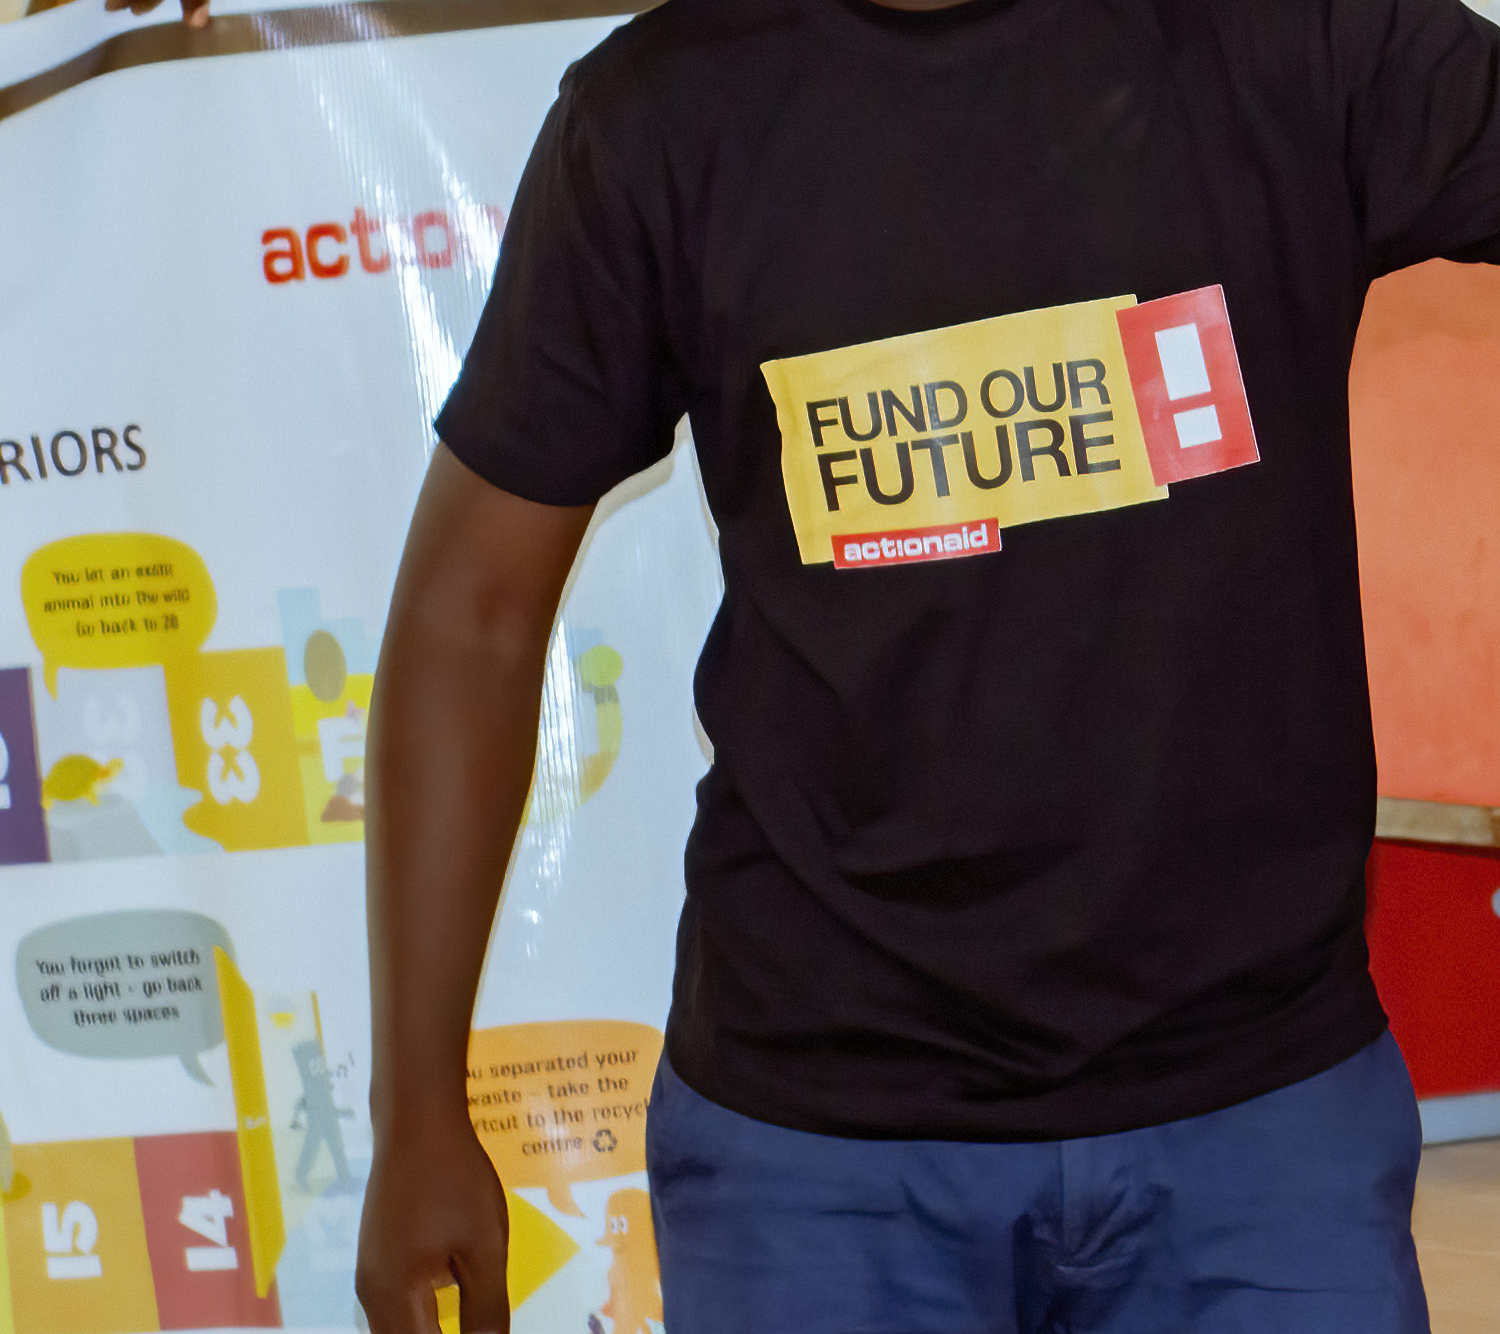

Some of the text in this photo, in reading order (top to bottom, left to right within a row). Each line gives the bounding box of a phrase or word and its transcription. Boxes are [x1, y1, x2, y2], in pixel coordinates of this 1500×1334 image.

[805, 358, 1112, 447] FUND OUR
[817, 410, 1122, 513] FUTURE
[44, 594, 95, 613] animal
[136, 588, 159, 605] the
[100, 617, 137, 635] back
[143, 616, 158, 632] to
[35, 947, 201, 977] You forgot to switch
[40, 983, 61, 1003] off
[83, 980, 122, 1003] light
[143, 981, 162, 999] go
[167, 976, 204, 994] back
[73, 1004, 181, 1028] three spaces
[490, 1051, 590, 1079] separated
[595, 1048, 640, 1068] your
[548, 1080, 590, 1099] take
[597, 1076, 628, 1094] the
[527, 1112, 546, 1129] to
[554, 1108, 585, 1126] the
[521, 1136, 583, 1156] centre
[42, 1200, 102, 1279] 15
[178, 1188, 240, 1272] 14
